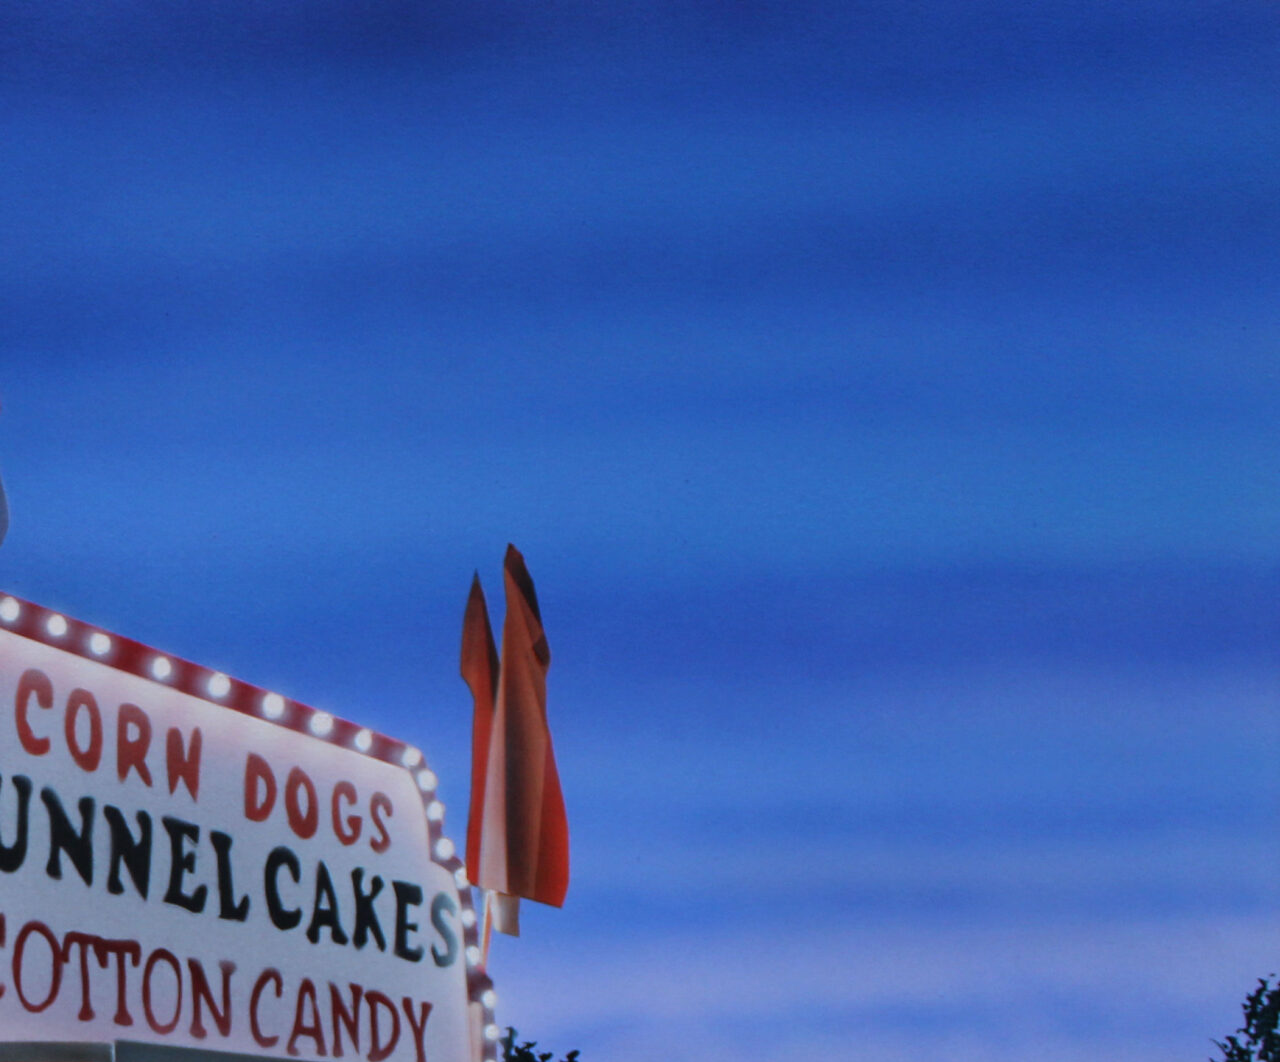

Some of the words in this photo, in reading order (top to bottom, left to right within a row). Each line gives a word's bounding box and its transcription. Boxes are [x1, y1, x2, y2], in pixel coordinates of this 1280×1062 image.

[15, 669, 203, 801] CORN
[244, 752, 393, 853] DOGS
[264, 846, 460, 968] CAKES
